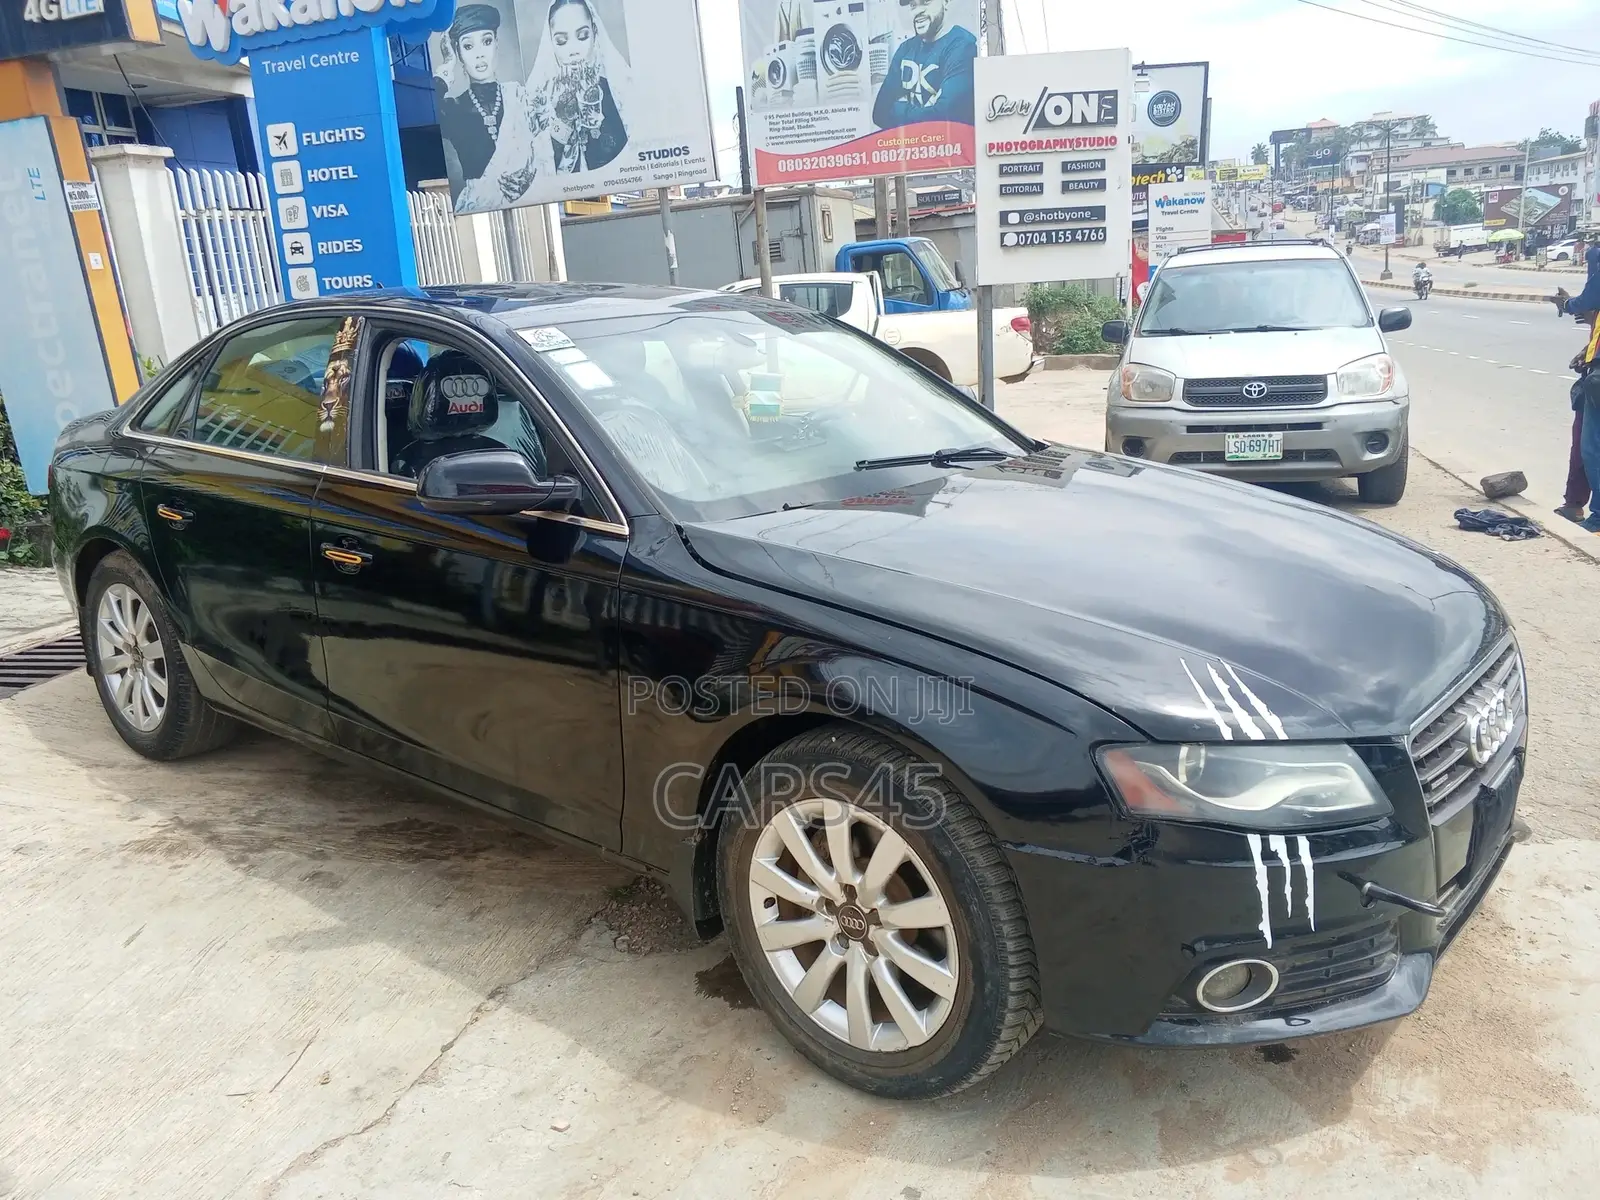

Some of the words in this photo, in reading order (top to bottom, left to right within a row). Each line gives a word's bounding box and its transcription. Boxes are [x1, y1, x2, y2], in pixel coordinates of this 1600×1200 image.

[262, 58, 306, 75] Travel
[309, 51, 360, 69] Centre
[302, 127, 366, 146] FLIGHTS
[877, 136, 918, 148] Customer
[920, 134, 945, 145] Care:
[638, 145, 691, 162] STUDIOS
[872, 143, 962, 164] 08027338404
[619, 164, 646, 174] Portraits
[650, 159, 680, 170] Editorials
[684, 156, 706, 165] Events
[1002, 163, 1041, 173] PORTRAIT
[1067, 161, 1102, 171] FASHION
[307, 166, 359, 183] HOTEL
[562, 182, 595, 193] Shotbyone
[603, 175, 643, 187] 07041554766
[652, 172, 674, 181] Sango
[677, 167, 708, 179] Ringroad
[27, 166, 47, 201] LTE
[1001, 185, 1042, 194] EDITORIAL
[1068, 181, 1100, 190] BEAUTY
[1154, 195, 1206, 209] Wakanow
[311, 203, 349, 219] VISA
[1023, 210, 1098, 223] @shotbyone_
[1018, 232, 1047, 246] 0704
[1051, 230, 1072, 243] 155
[1075, 228, 1105, 242] 4766
[317, 239, 364, 255] RIDES
[322, 274, 374, 290] TOURS
[447, 401, 484, 415] Audi
